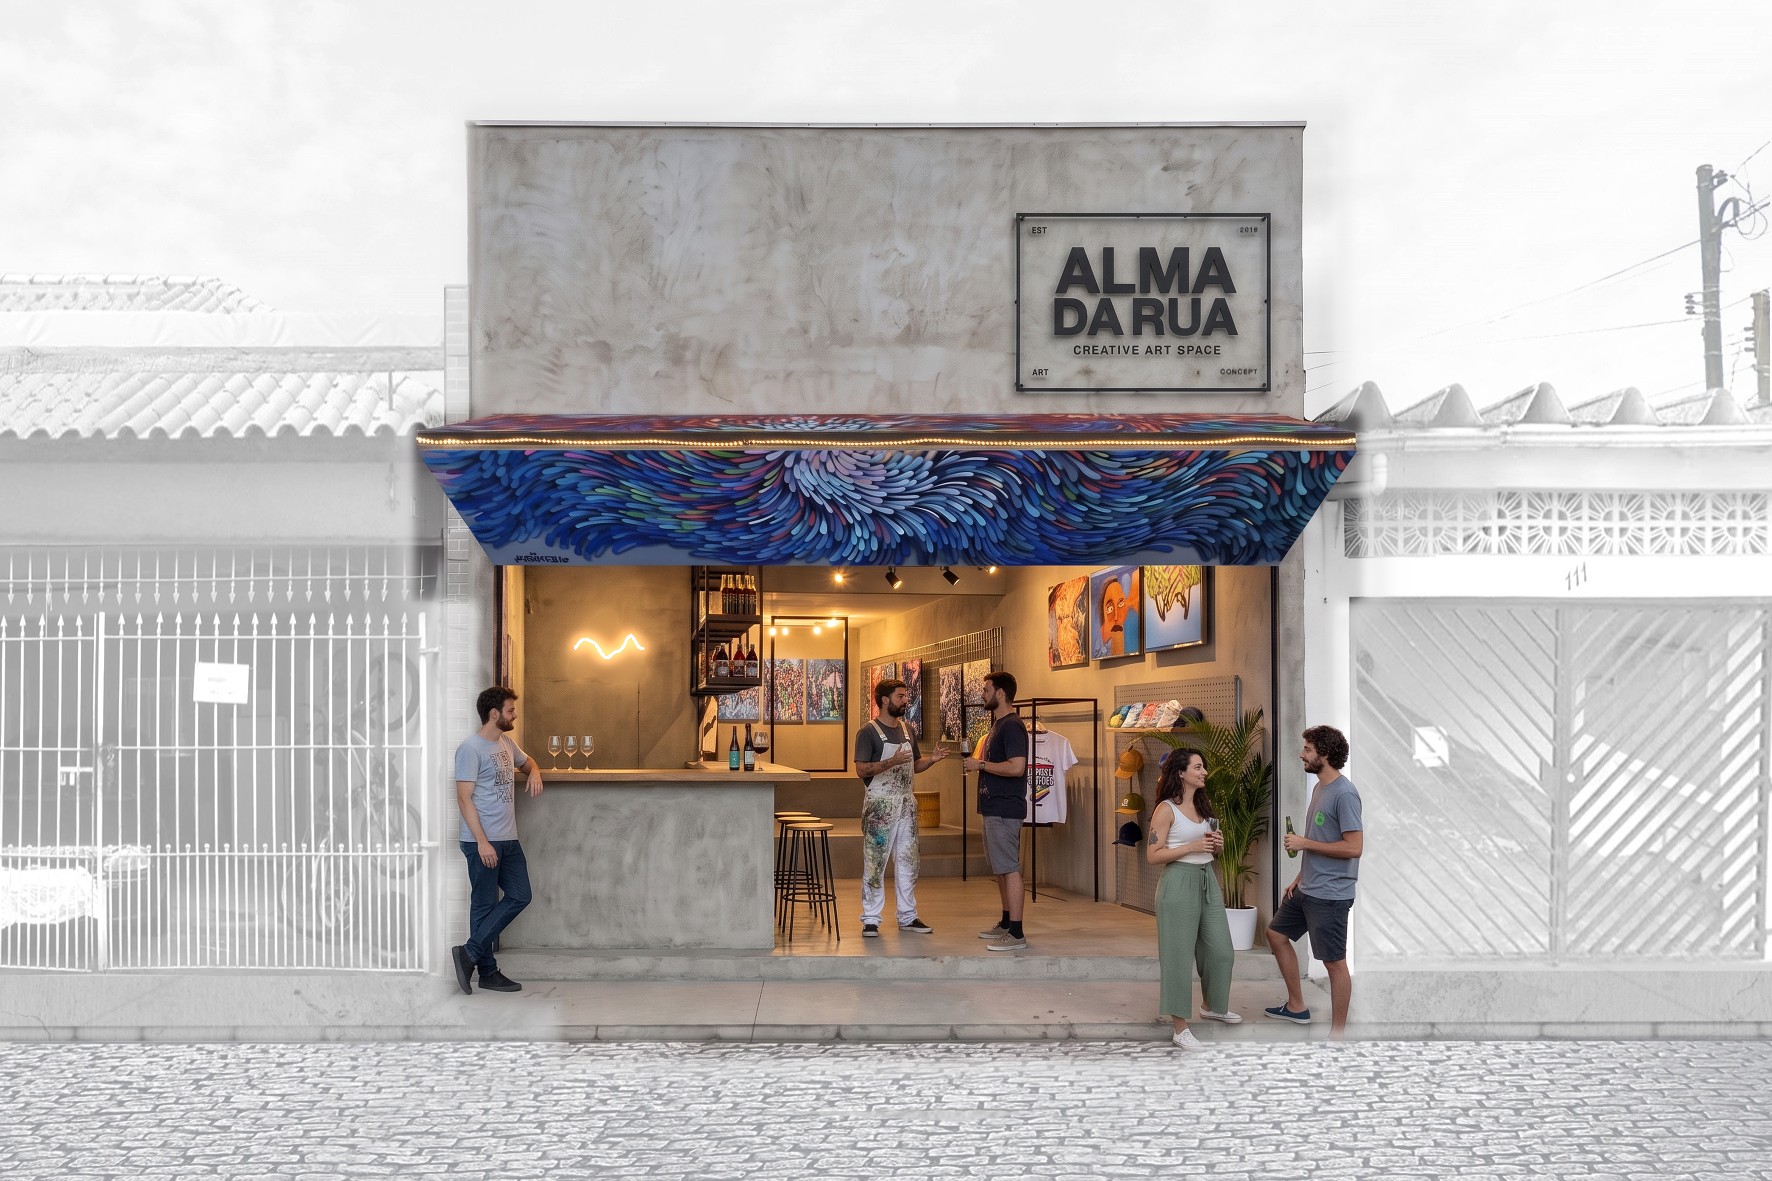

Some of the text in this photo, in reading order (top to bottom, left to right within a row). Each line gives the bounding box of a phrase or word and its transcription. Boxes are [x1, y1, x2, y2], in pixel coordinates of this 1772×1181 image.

[1055, 247, 1237, 294] ALMA
[1073, 345, 1221, 355] CREATIVE ART SPACE
[1031, 368, 1049, 376] ART
[1564, 561, 1588, 591] 111
